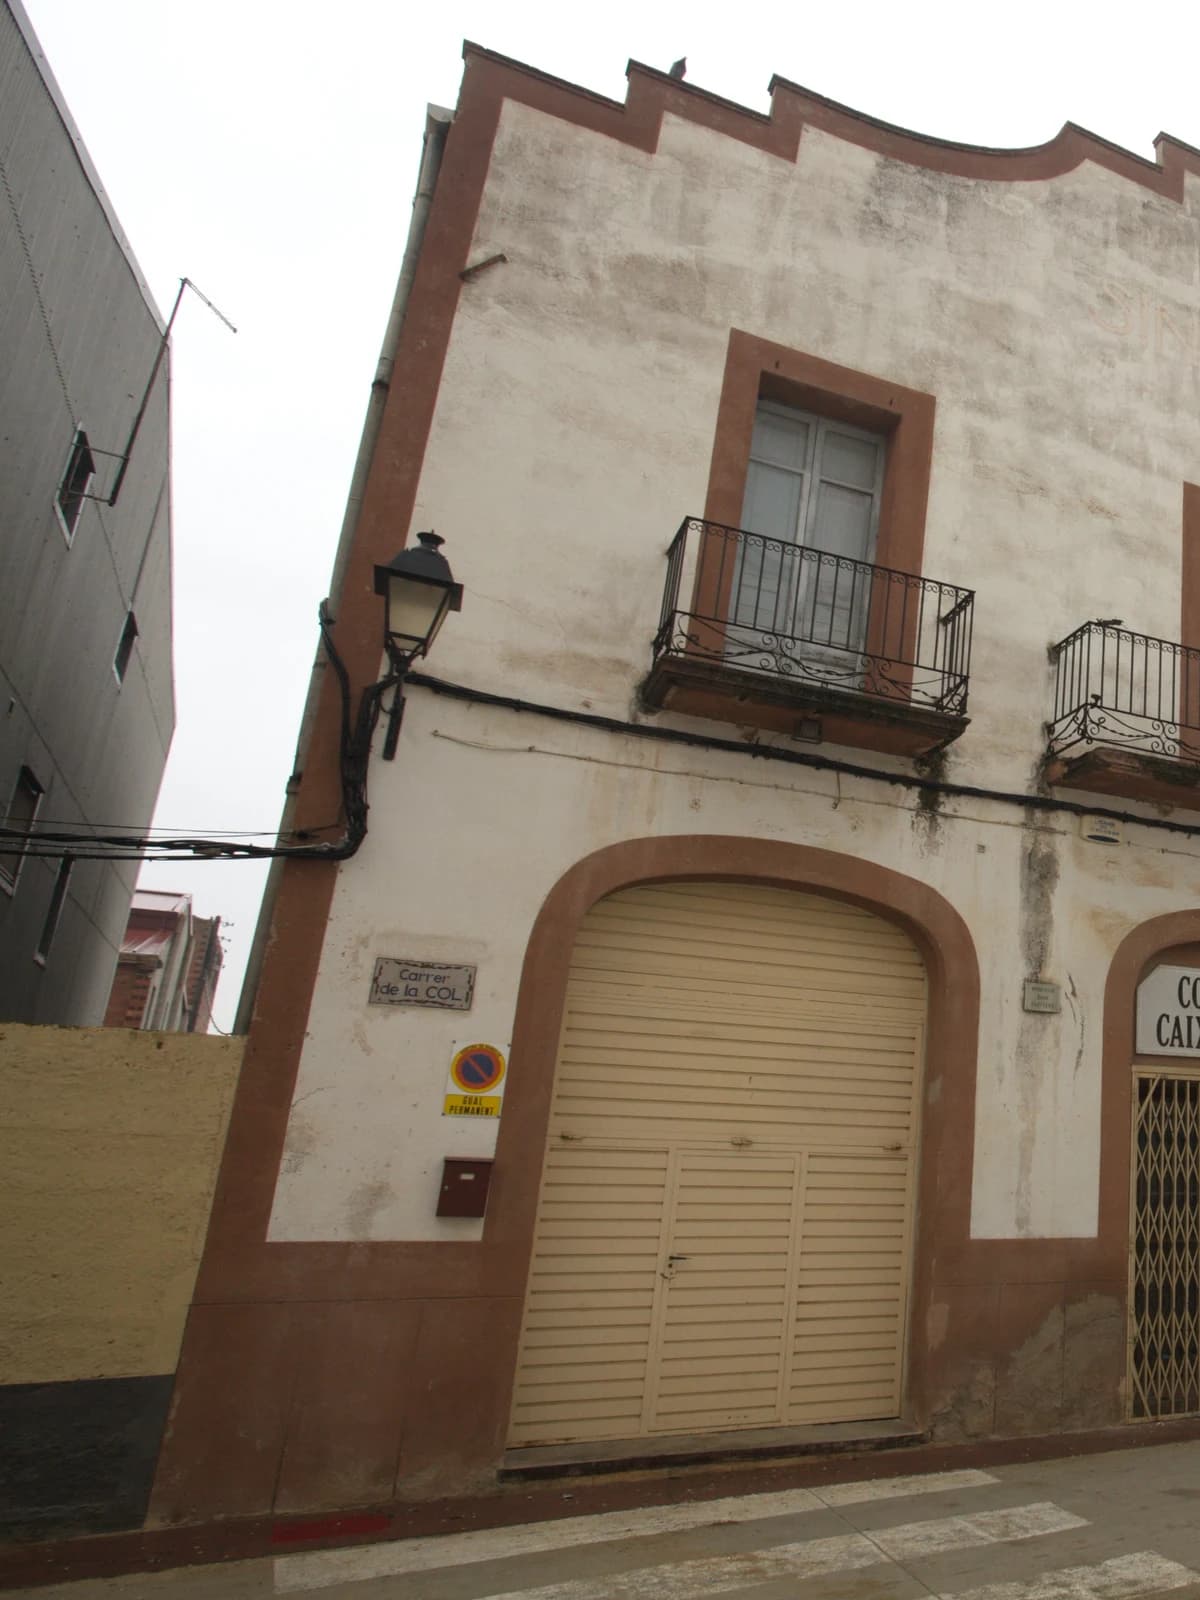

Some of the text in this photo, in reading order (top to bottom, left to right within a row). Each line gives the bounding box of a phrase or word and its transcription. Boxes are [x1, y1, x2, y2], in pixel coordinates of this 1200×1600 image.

[399, 968, 451, 984] Carrer
[380, 982, 463, 1001] de la COL
[462, 1095, 483, 1106] GUAL
[450, 1105, 495, 1116] PERMANENT
